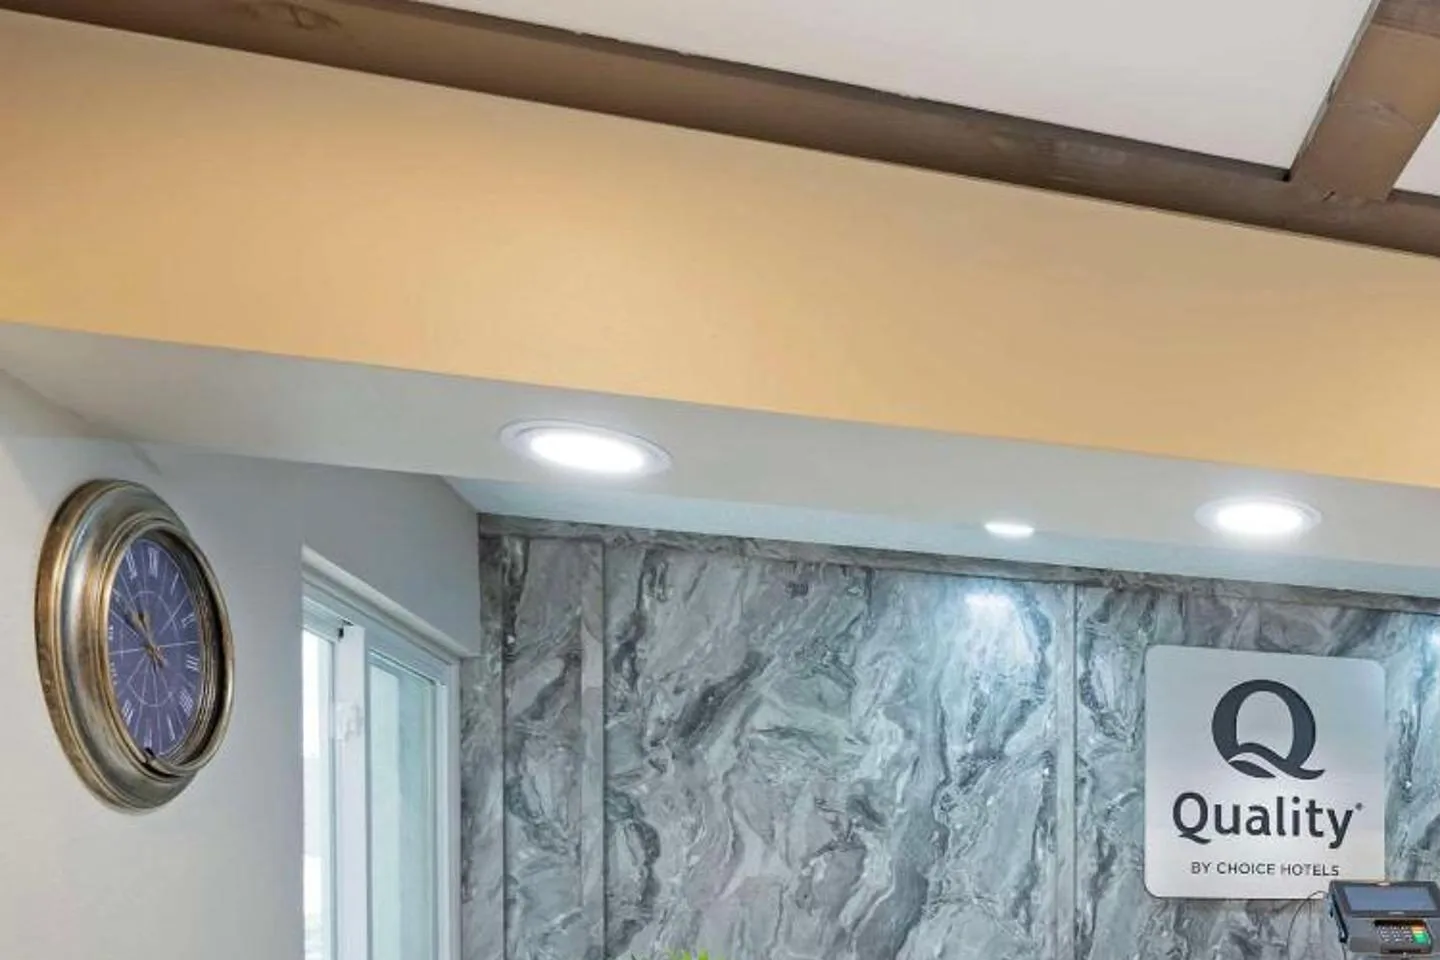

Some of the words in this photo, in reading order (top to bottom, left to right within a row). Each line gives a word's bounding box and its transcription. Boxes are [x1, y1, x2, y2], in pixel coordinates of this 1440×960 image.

[1211, 679, 1326, 780] Q
[1172, 792, 1354, 849] Quality
[1191, 861, 1211, 875] BY
[1216, 862, 1276, 876] CHOICE
[1280, 863, 1340, 877] HOTELS
